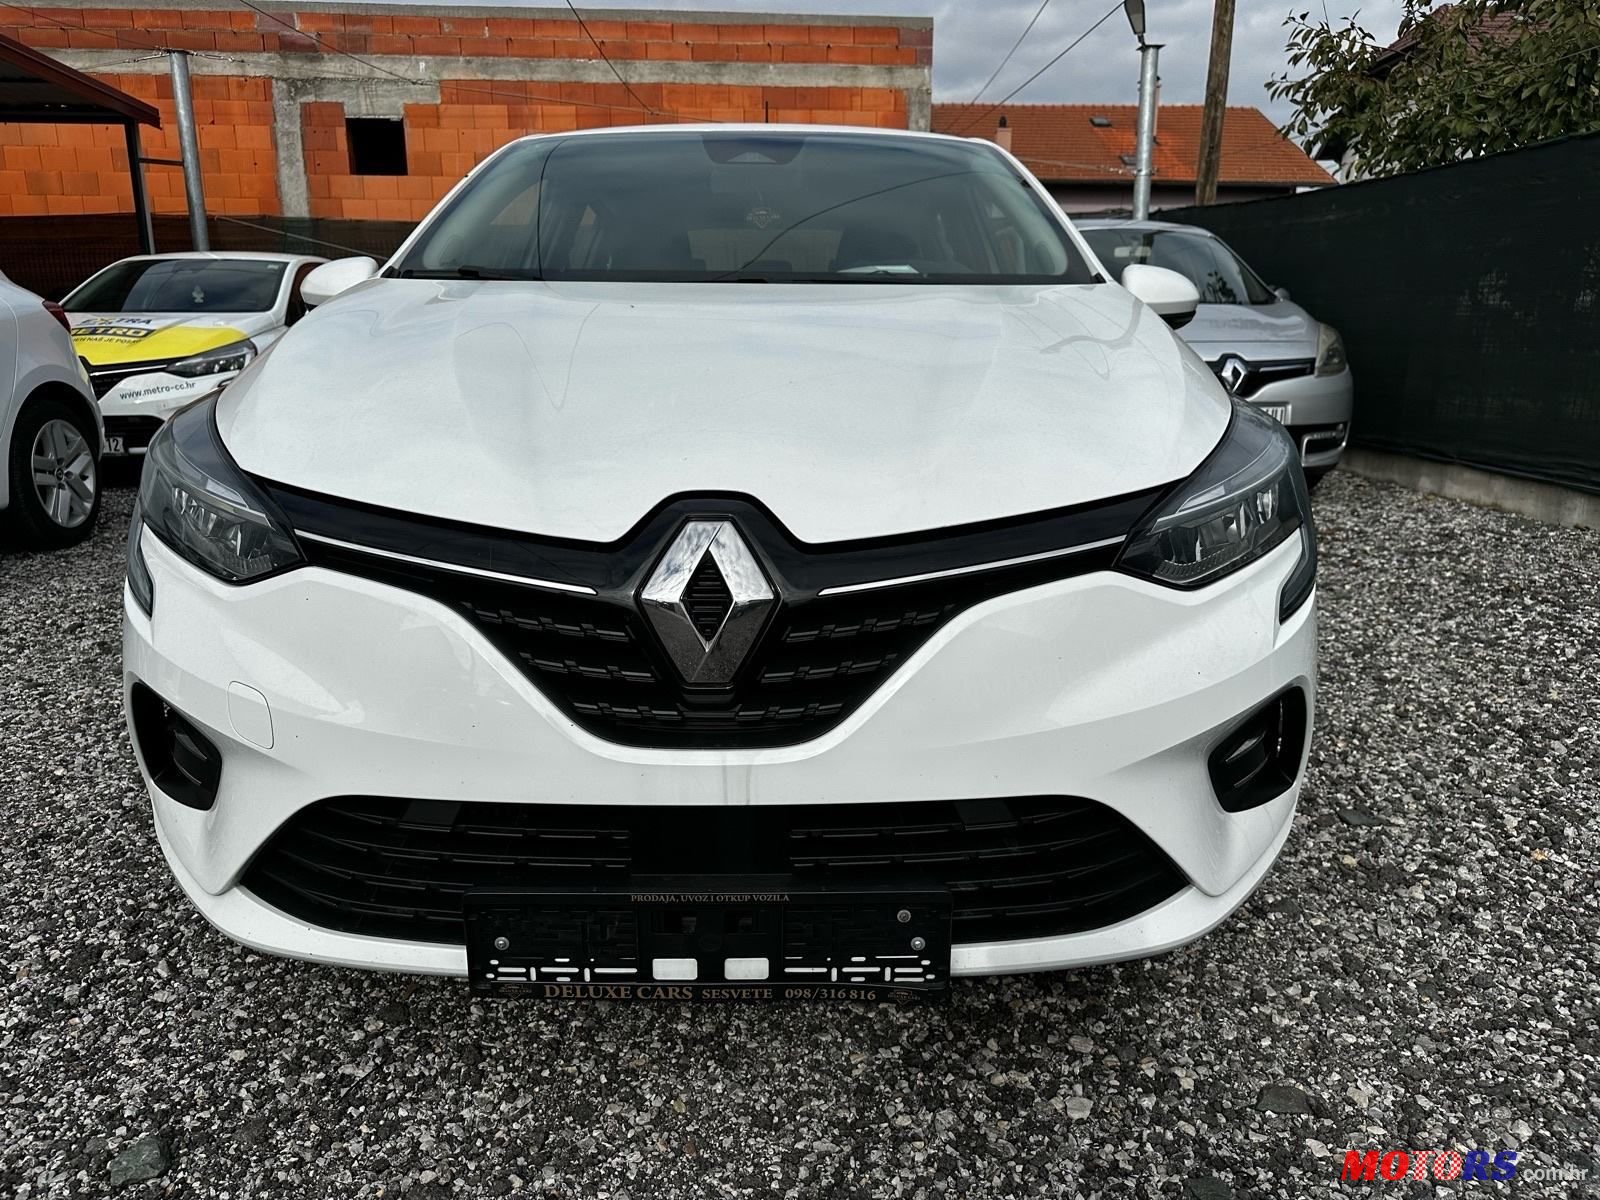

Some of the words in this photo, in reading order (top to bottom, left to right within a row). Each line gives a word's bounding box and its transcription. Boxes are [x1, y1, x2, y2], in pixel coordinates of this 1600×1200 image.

[120, 381, 196, 399] www.metro-cc.hr
[631, 894, 679, 903] PRODAJA,
[681, 894, 709, 902] UVOZ
[716, 894, 751, 902] OTKUP
[752, 894, 790, 902] VOZILA
[543, 984, 632, 999] DELUXE
[636, 985, 693, 999] CARS
[702, 988, 773, 999] SESVETE
[785, 987, 846, 1000] 098/316
[850, 990, 876, 1000] 816
